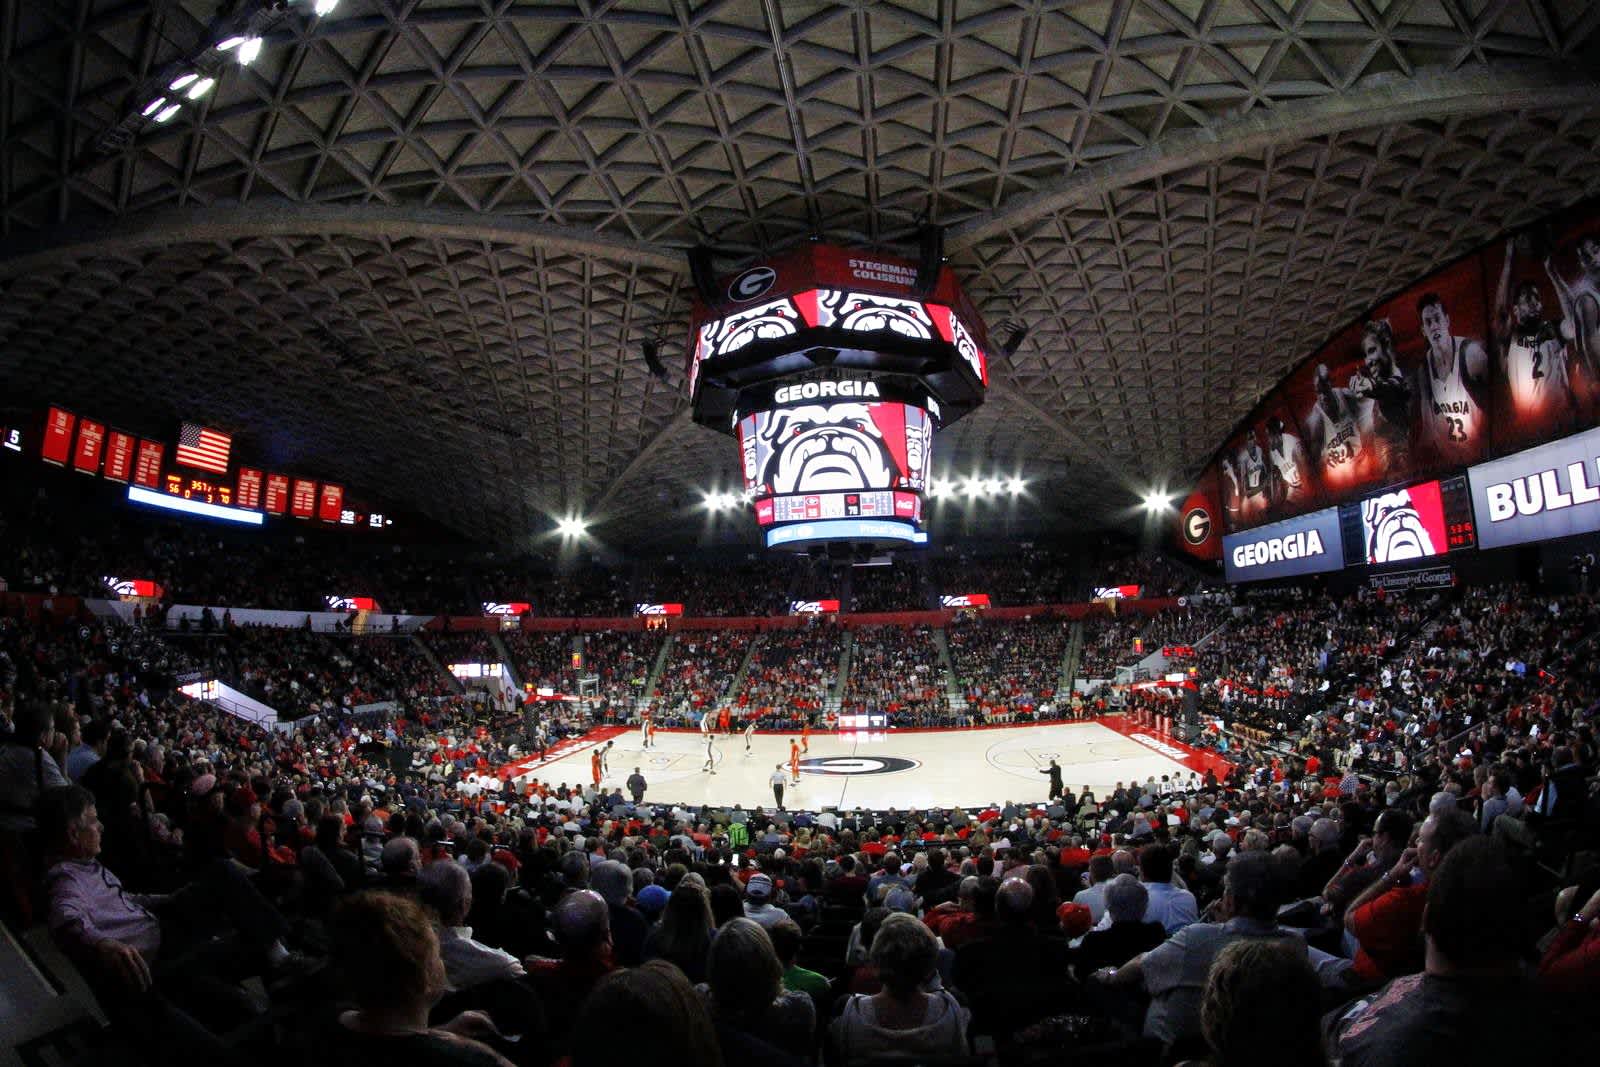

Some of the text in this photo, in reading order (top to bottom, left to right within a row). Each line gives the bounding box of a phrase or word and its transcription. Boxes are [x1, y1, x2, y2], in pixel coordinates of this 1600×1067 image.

[849, 259, 918, 277] STEGEMAN
[853, 270, 916, 287] COLISEUM
[775, 381, 880, 404] GEORGIA
[1446, 417, 1468, 442] 23
[1486, 457, 1600, 522] BULL
[1187, 512, 1210, 540] G
[1233, 529, 1324, 569] GEORGIA
